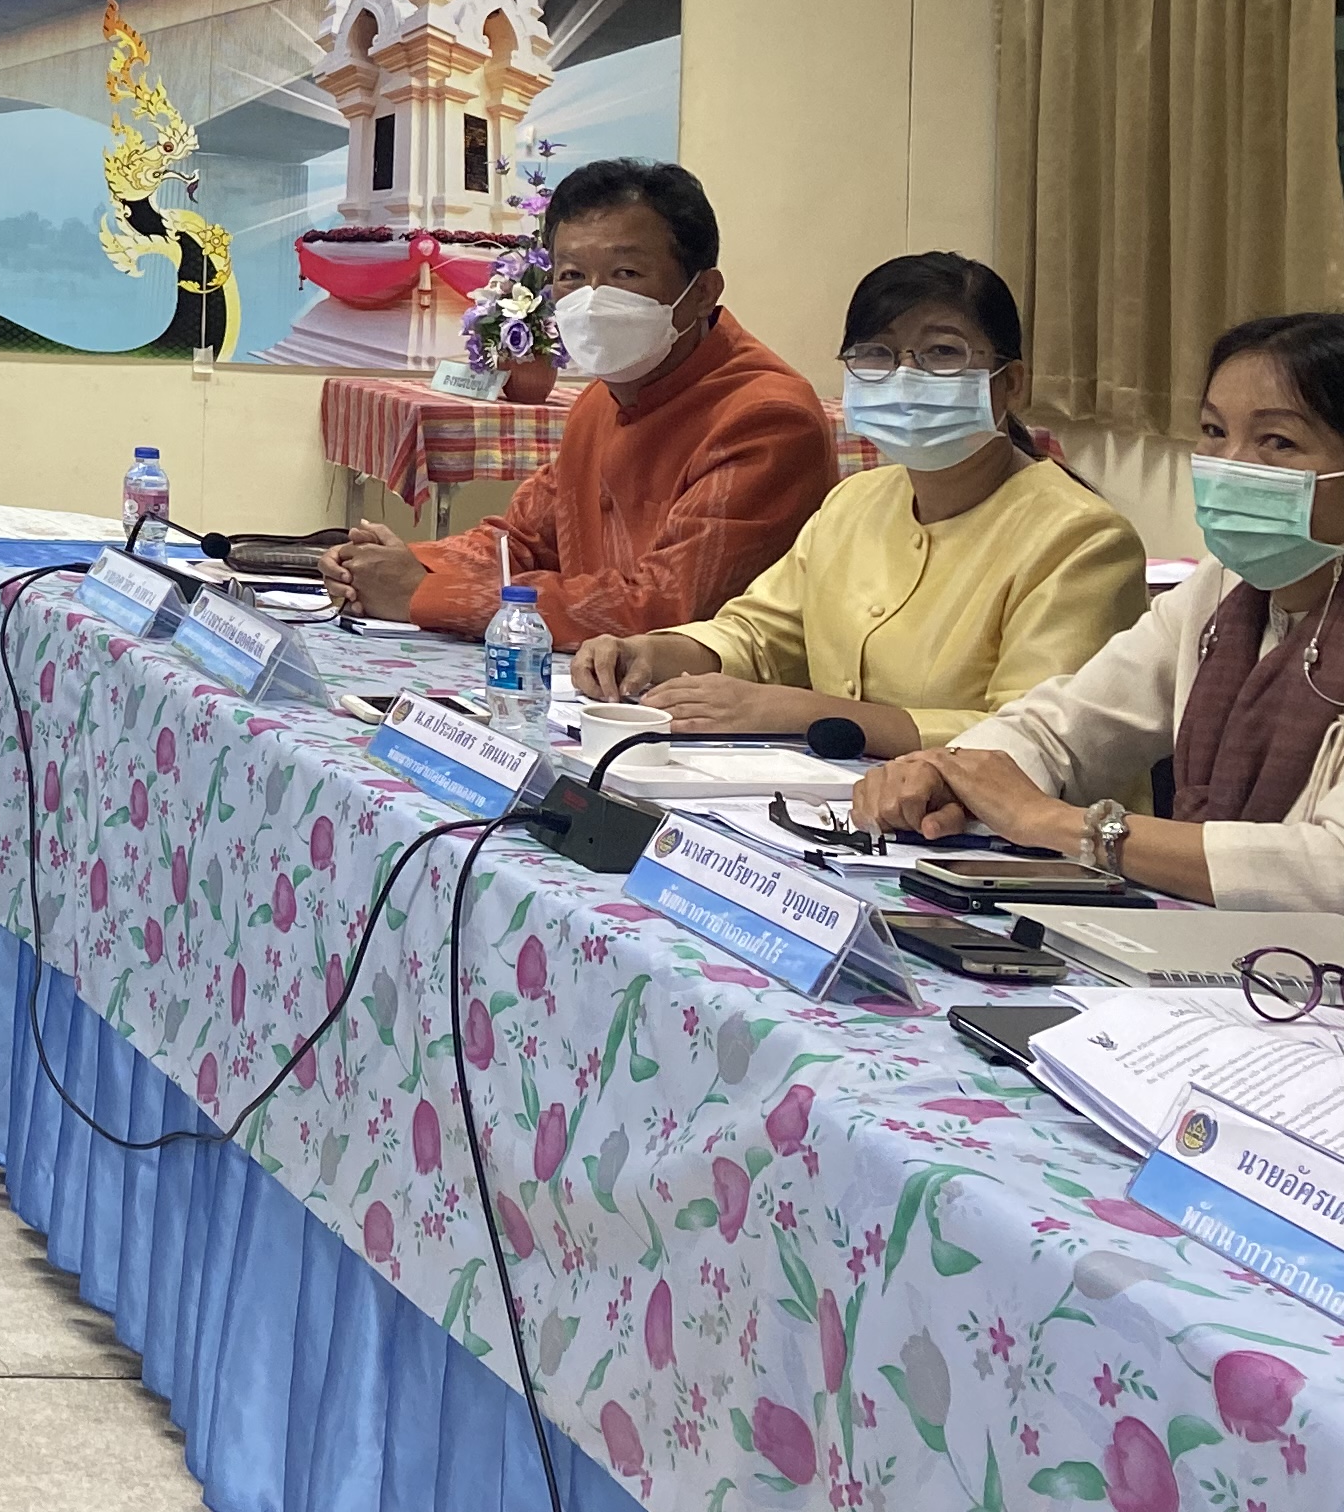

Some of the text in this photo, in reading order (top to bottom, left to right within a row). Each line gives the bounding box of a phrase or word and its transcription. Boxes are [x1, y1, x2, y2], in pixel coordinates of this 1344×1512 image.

[680, 839, 781, 897] นางสาวปรียาวดี
